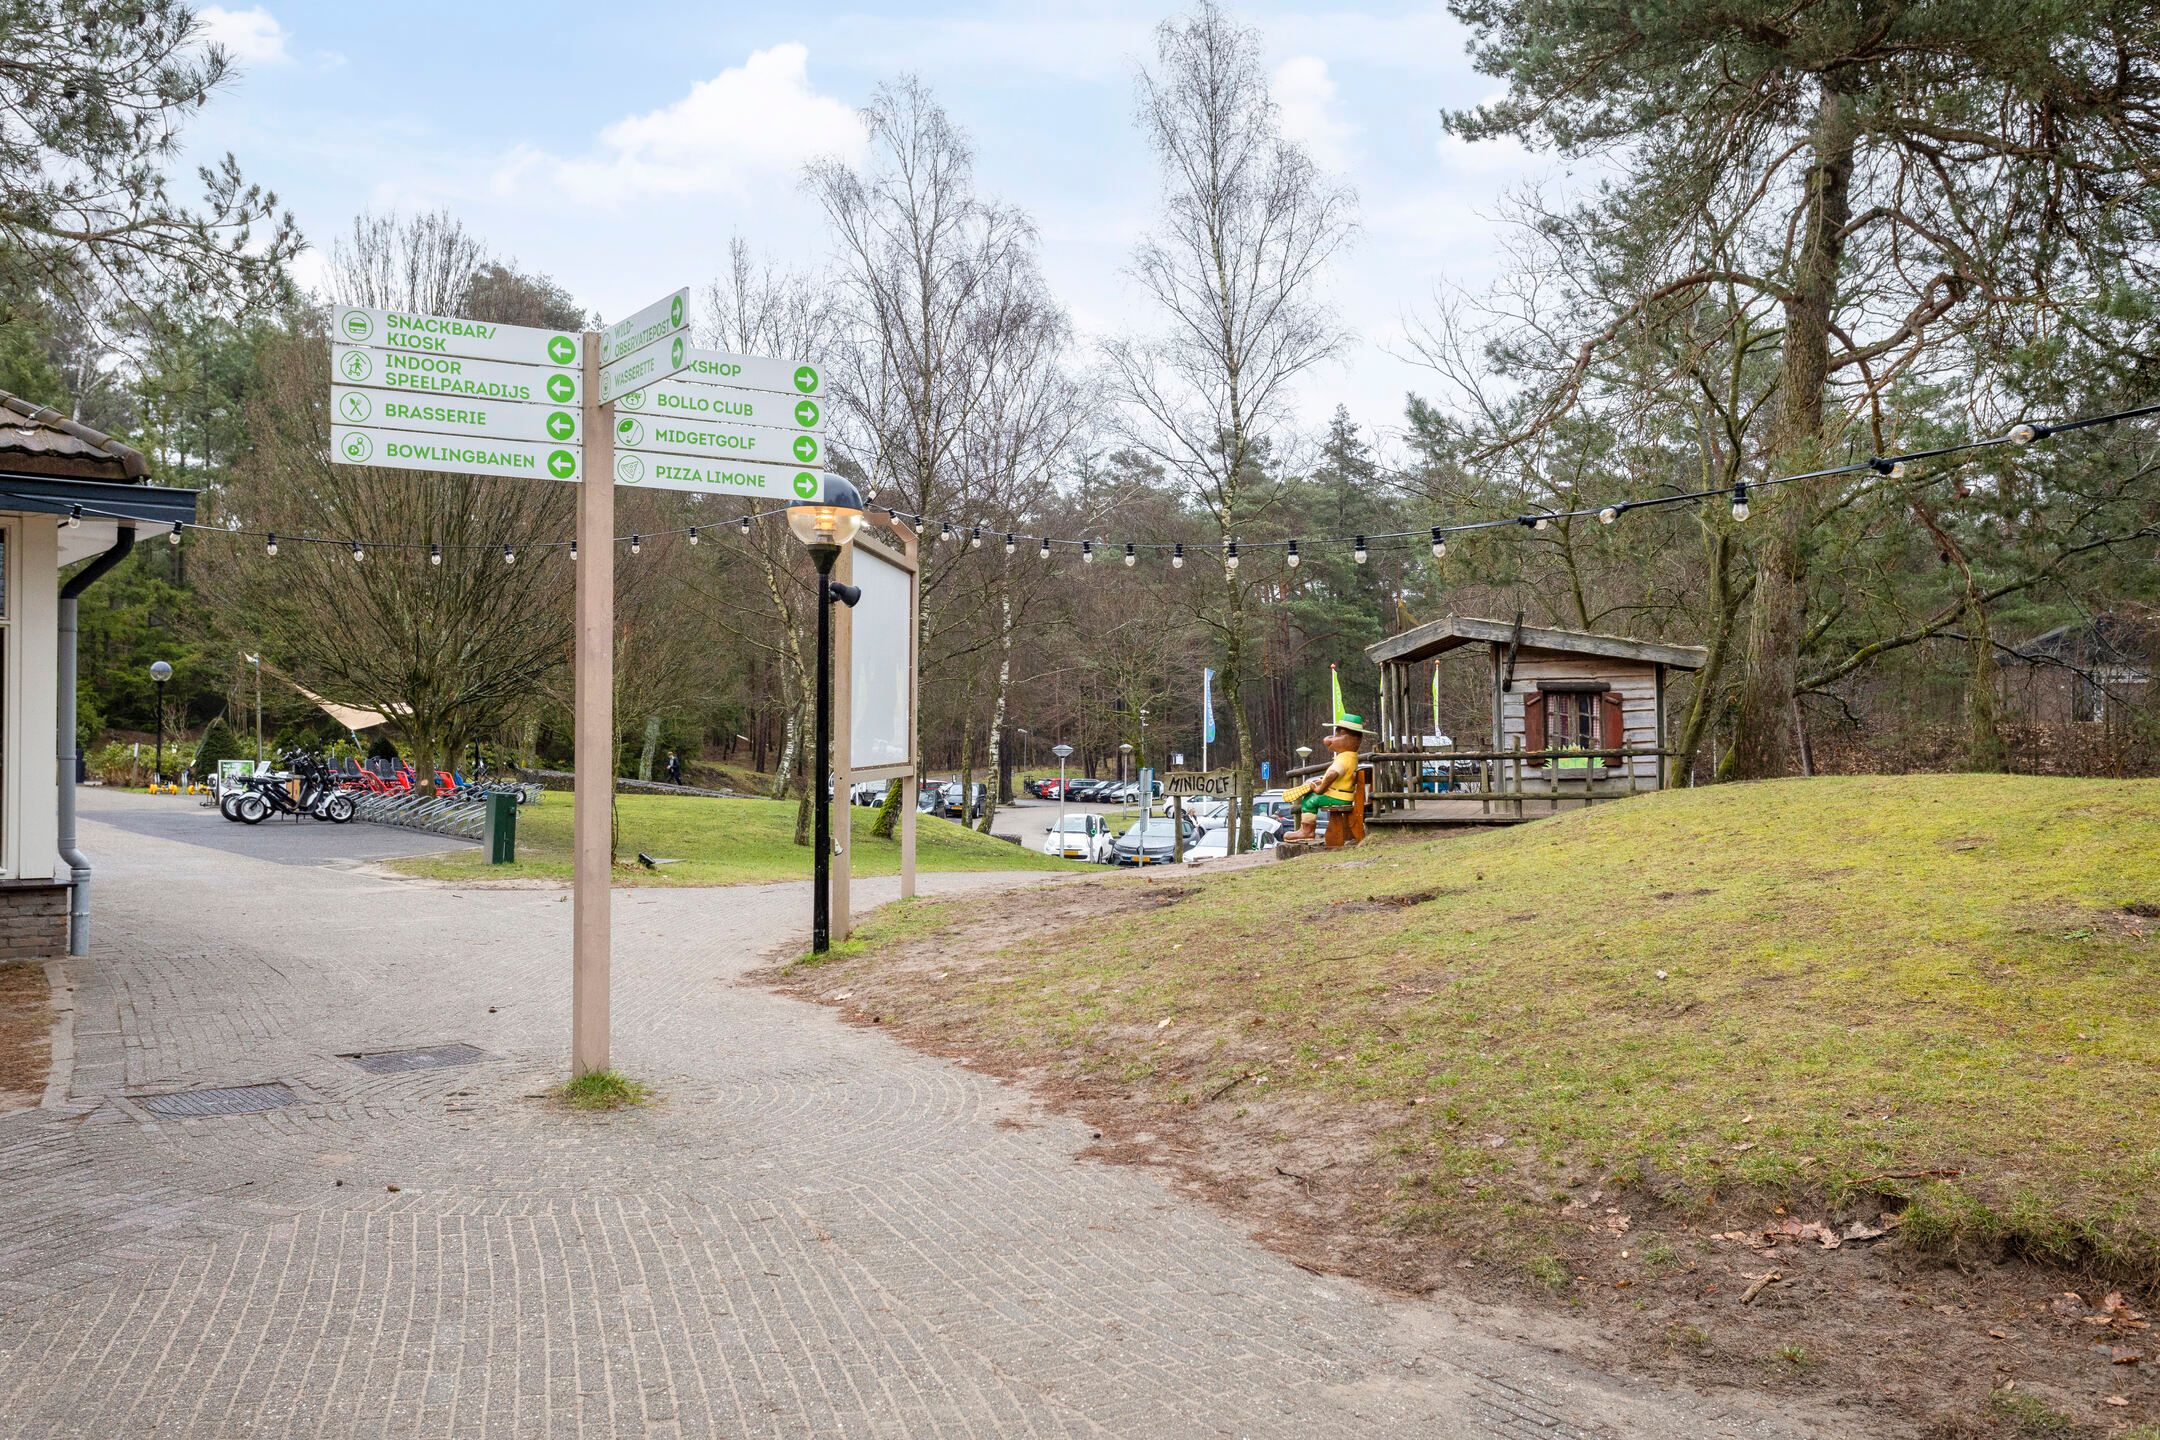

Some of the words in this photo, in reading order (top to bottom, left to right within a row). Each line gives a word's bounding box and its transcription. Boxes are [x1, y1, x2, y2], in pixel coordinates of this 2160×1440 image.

[386, 313, 496, 339] SNACKBAR/
[614, 320, 635, 339] WILD-
[386, 332, 446, 352] KIOSK
[614, 318, 670, 358] OBSERVATIEPOST
[385, 353, 462, 375] INDOOR
[614, 357, 655, 387] WASSERETTE
[385, 371, 530, 400] SPEELPARADIJS
[384, 403, 486, 426] BRASSERIE
[657, 392, 710, 412] BOLLO
[712, 399, 753, 417] CLUB
[655, 428, 756, 450] MIDGETGOLF
[386, 442, 536, 468] BOWLINGBANEN
[655, 465, 703, 481] PIZZA
[706, 470, 765, 488] LIMONE
[1168, 776, 1230, 794] MINIGOLF
